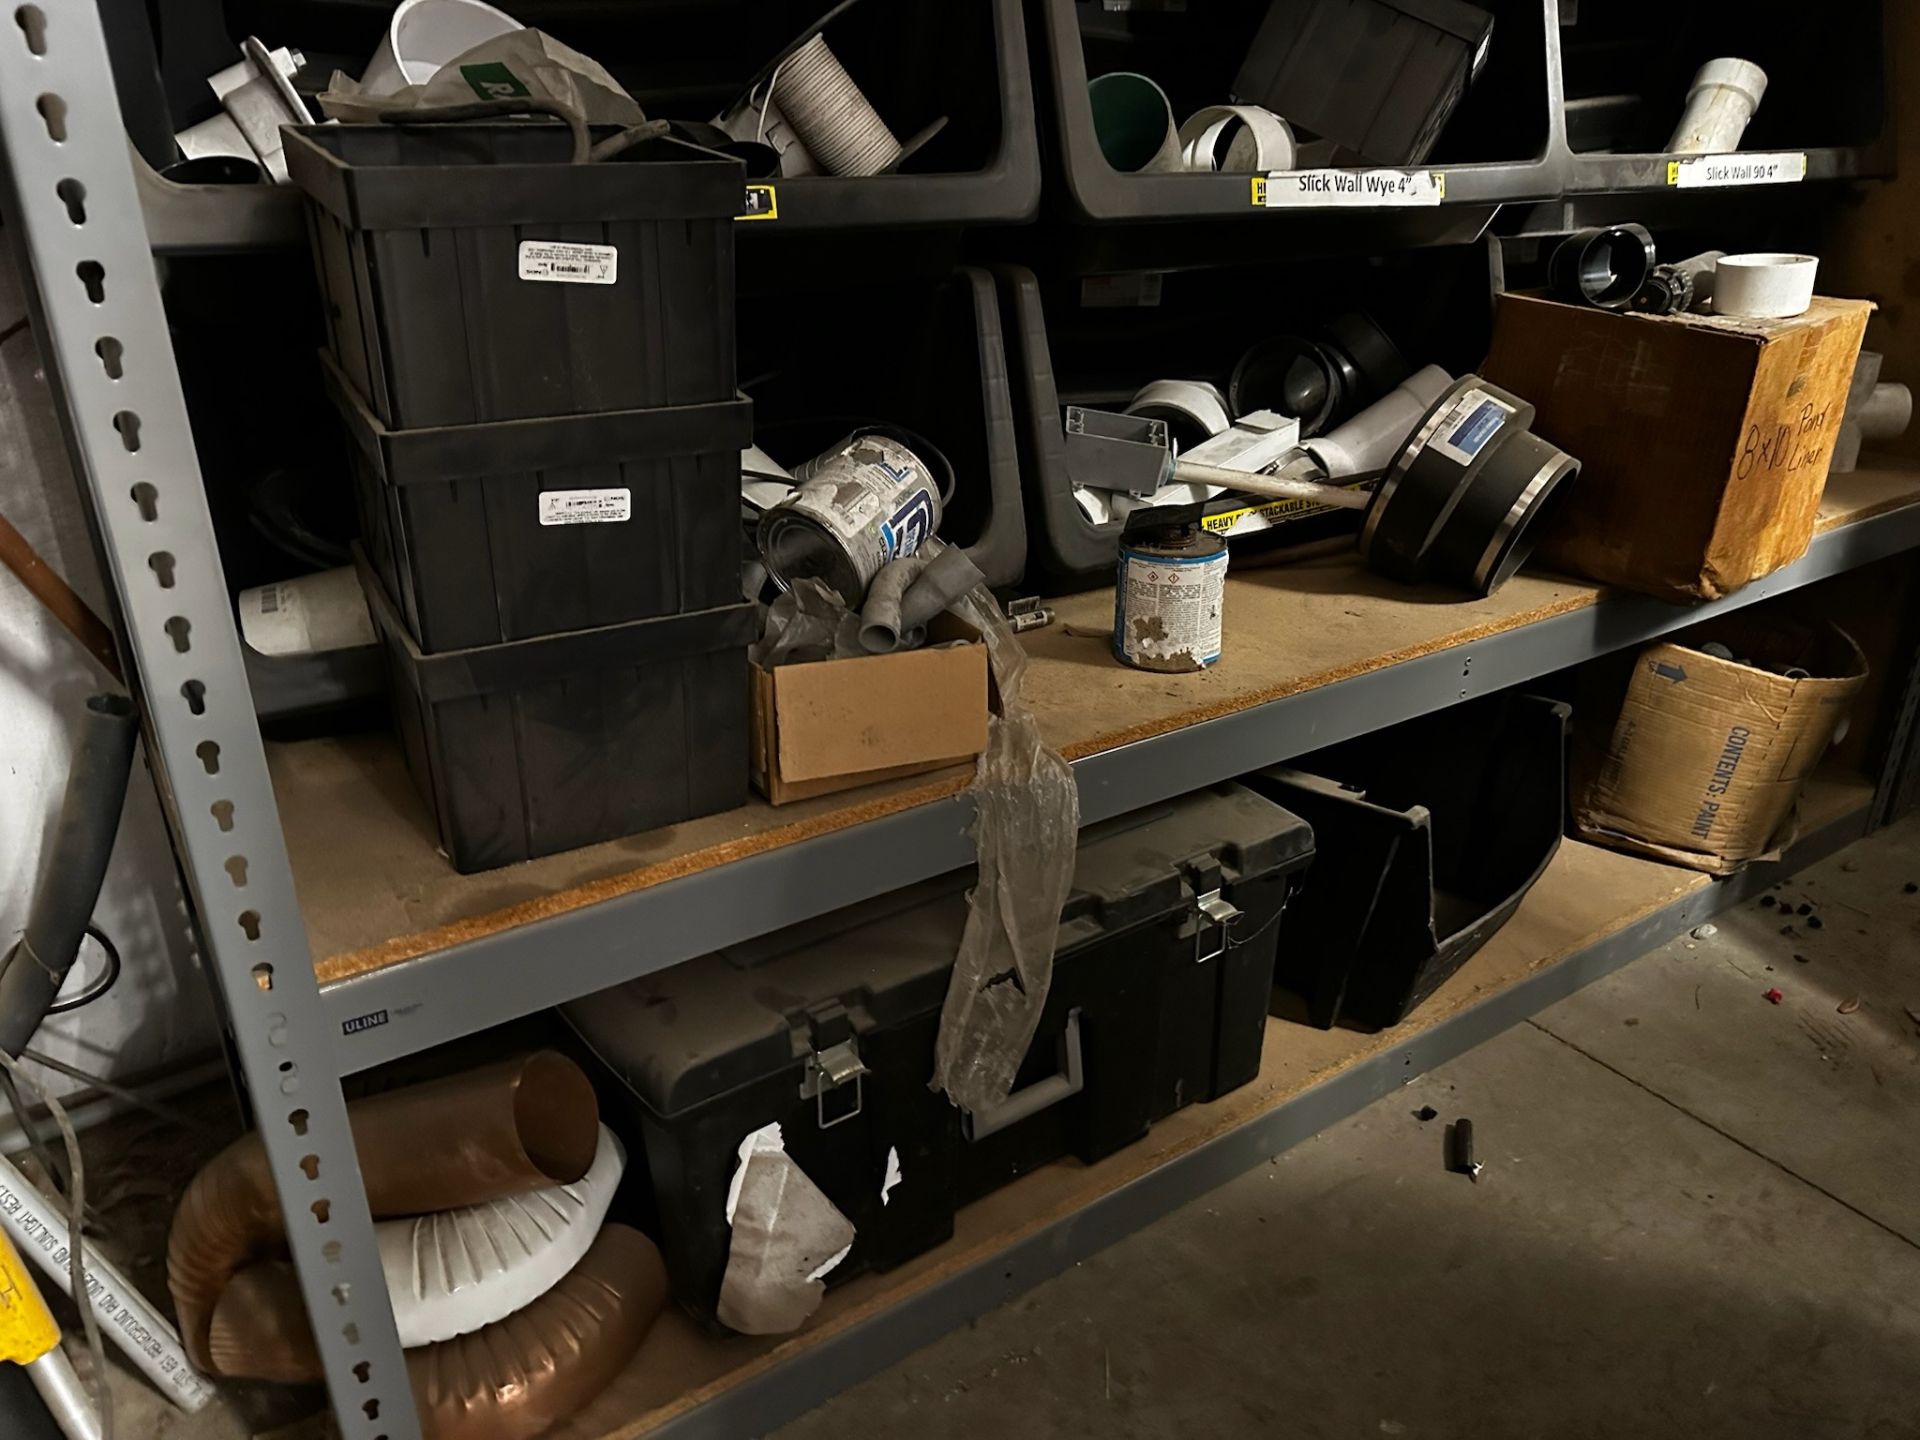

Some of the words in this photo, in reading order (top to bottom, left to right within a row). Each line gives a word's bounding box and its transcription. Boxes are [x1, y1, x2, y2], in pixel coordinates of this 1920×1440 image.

[1298, 174, 1331, 192] Slick
[1334, 175, 1362, 193] Wall
[1367, 177, 1395, 197] Wye
[1706, 165, 1729, 181] Slick
[1730, 164, 1752, 179] Wall
[1753, 165, 1765, 179] 90
[1787, 443, 1823, 473] Liner
[1206, 514, 1234, 531] HEAVY
[1260, 499, 1305, 517] STACKABLE
[1706, 725, 1751, 797] CONTENTS:
[1690, 799, 1721, 840] PAINT
[344, 1011, 387, 1034] ULINE
[14, 1208, 59, 1253] SUNLIGHT
[98, 1293, 121, 1316] AND
[112, 1307, 165, 1361] ABOVEGROUND
